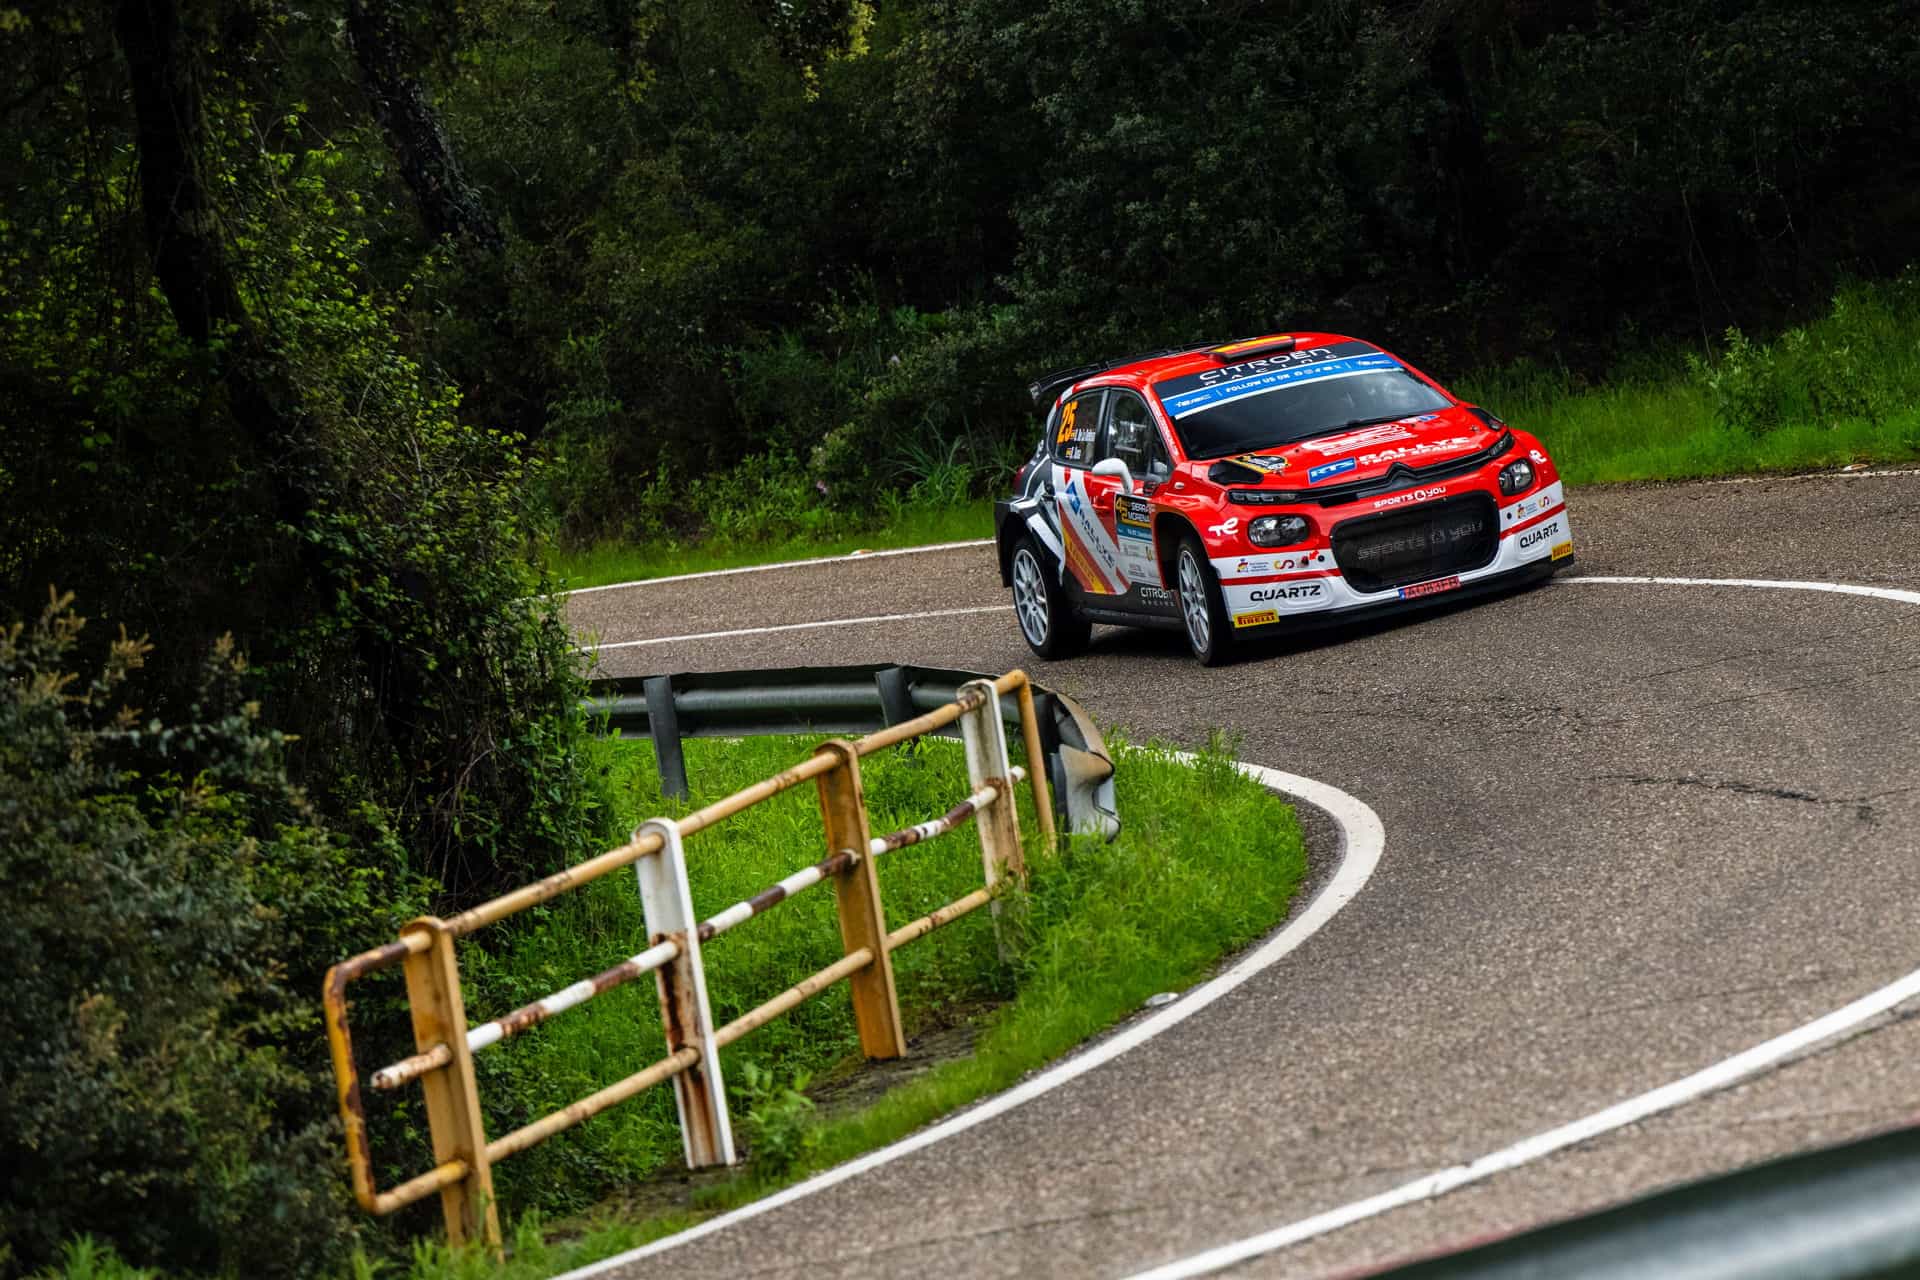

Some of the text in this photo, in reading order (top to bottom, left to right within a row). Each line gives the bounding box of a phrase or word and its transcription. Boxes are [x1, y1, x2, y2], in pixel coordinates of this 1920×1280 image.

[1226, 380, 1261, 393] FOLLOW
[1056, 400, 1078, 444] 25
[1519, 522, 1559, 549] QUARTZ
[1250, 584, 1321, 601] QUARTZ
